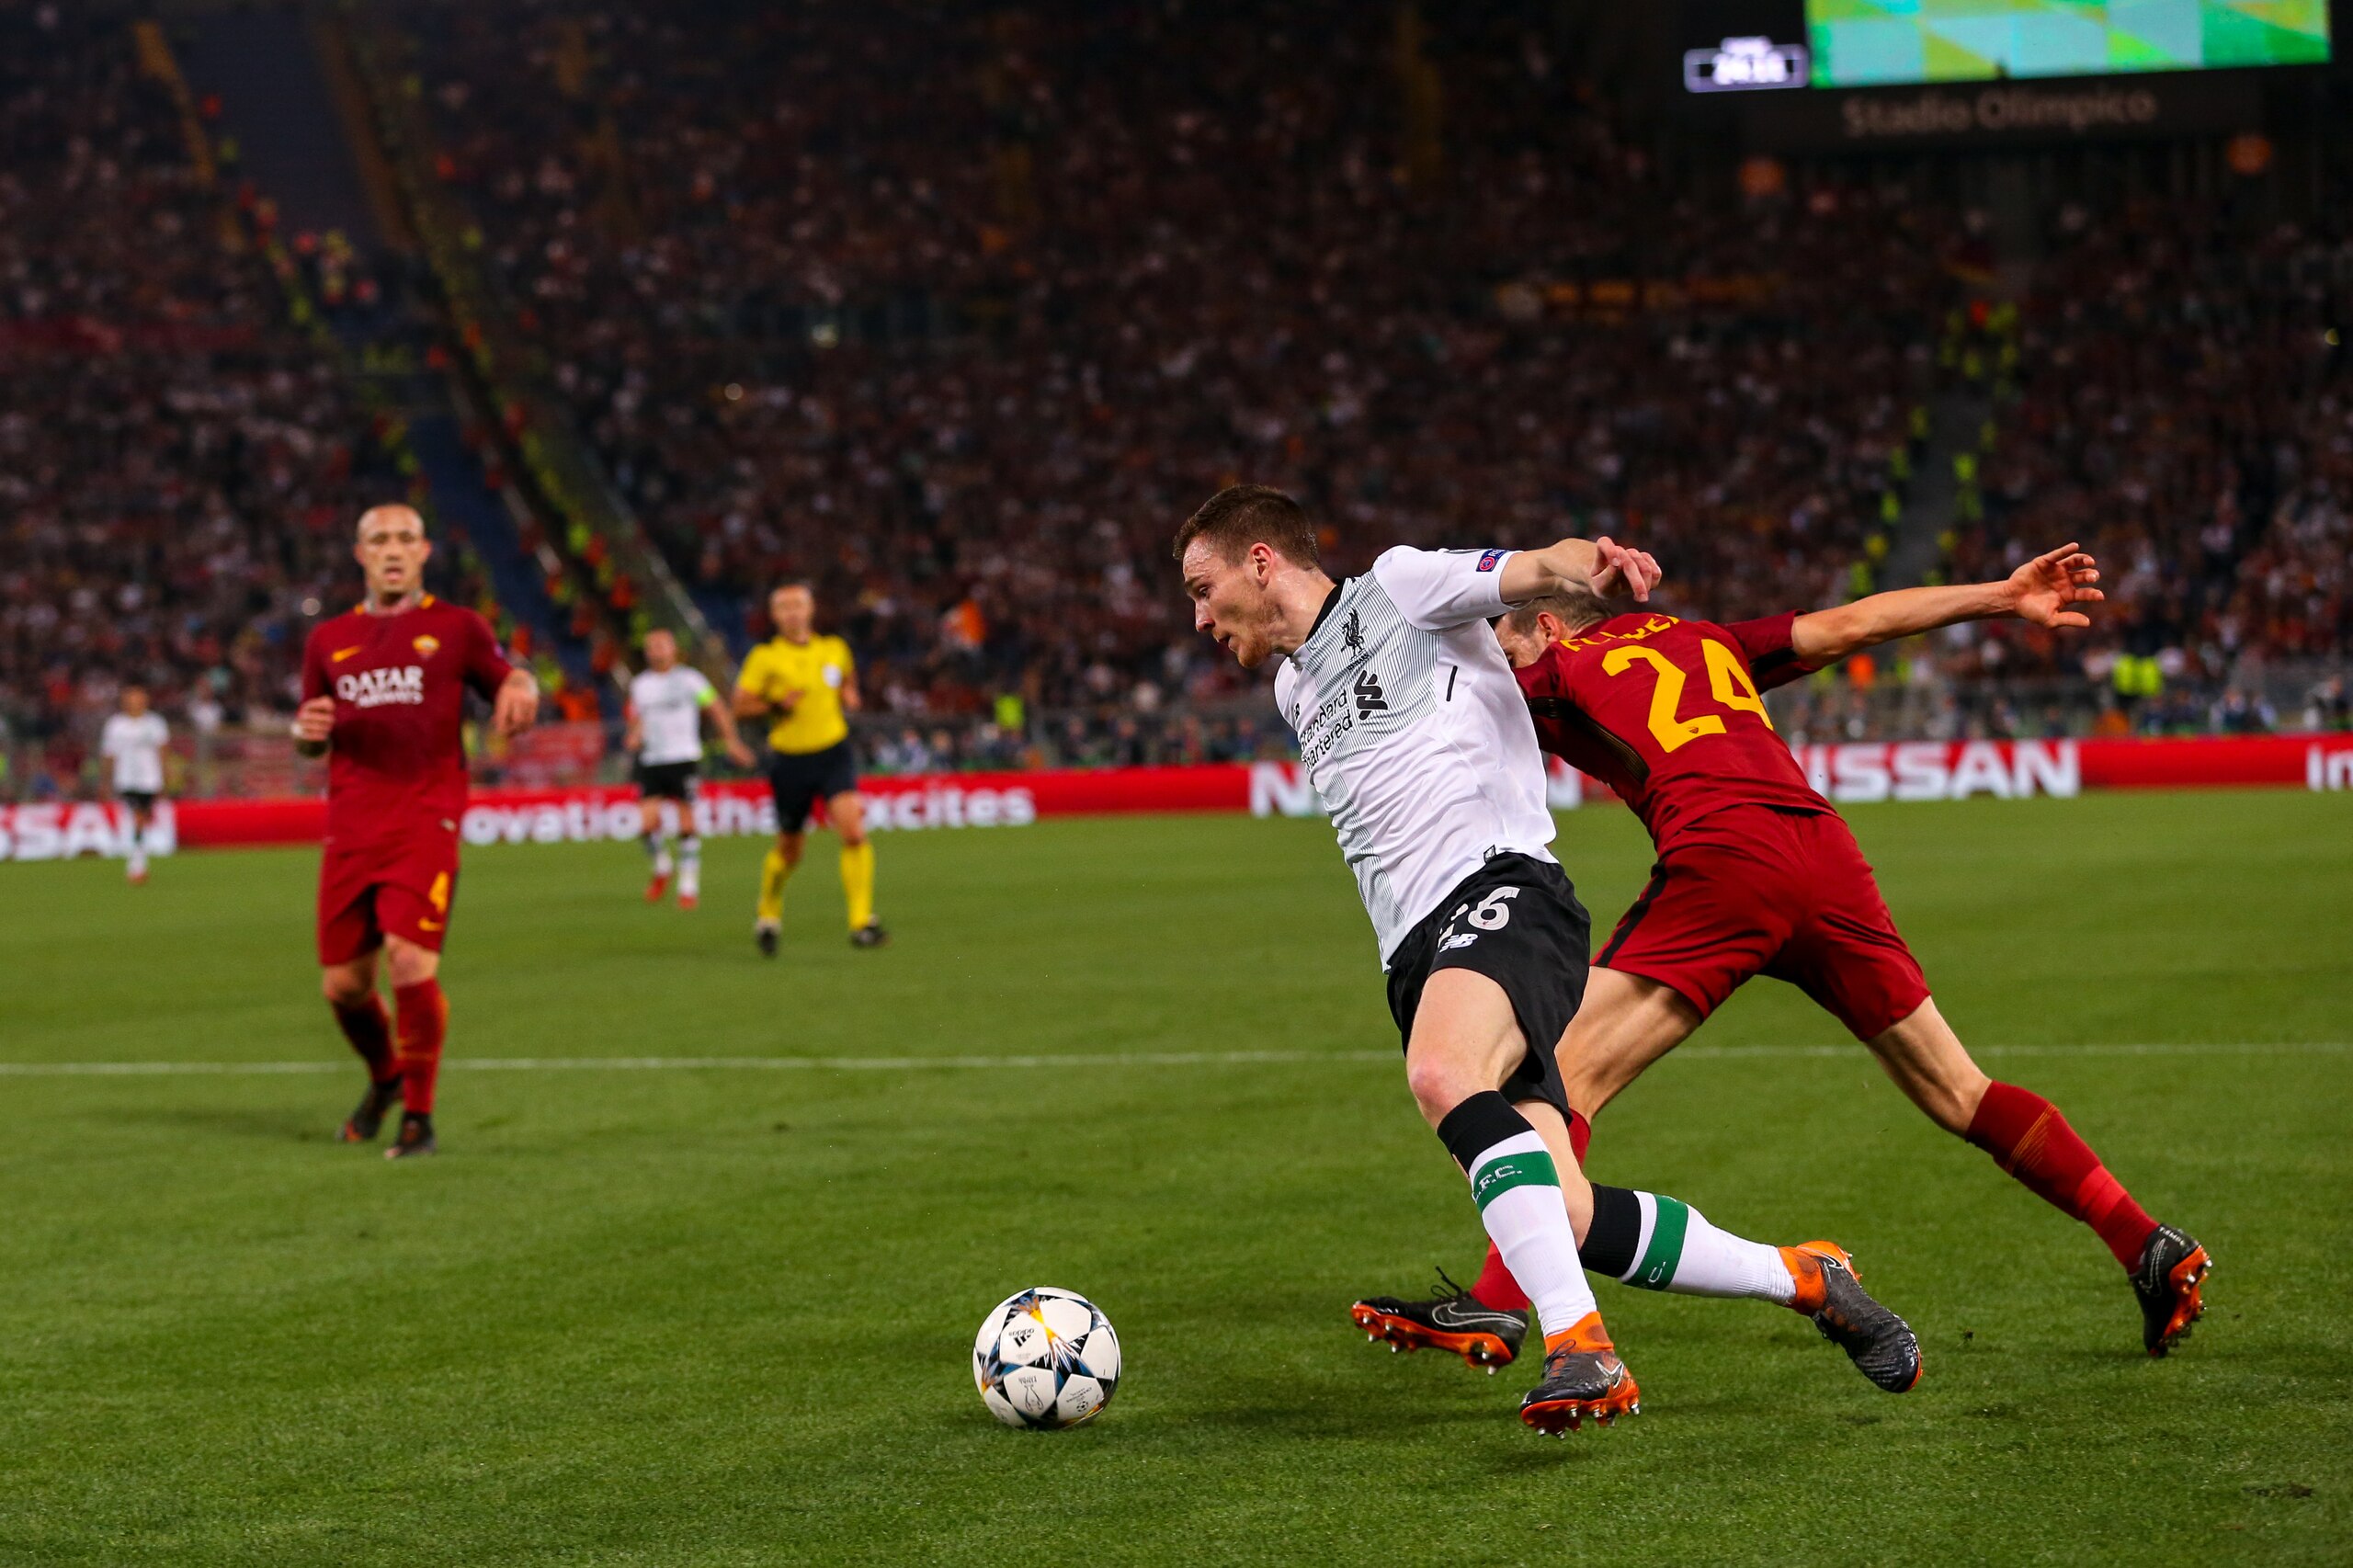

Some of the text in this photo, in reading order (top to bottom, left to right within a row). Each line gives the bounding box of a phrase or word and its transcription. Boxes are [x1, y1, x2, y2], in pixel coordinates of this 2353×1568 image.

[1842, 85, 2157, 137] Stadio Olimpico
[336, 665, 424, 701] QATAR
[1602, 639, 1775, 754] 24
[1794, 739, 2079, 802] ISSAN
[0, 801, 176, 860] SAN
[428, 870, 449, 915] 4
